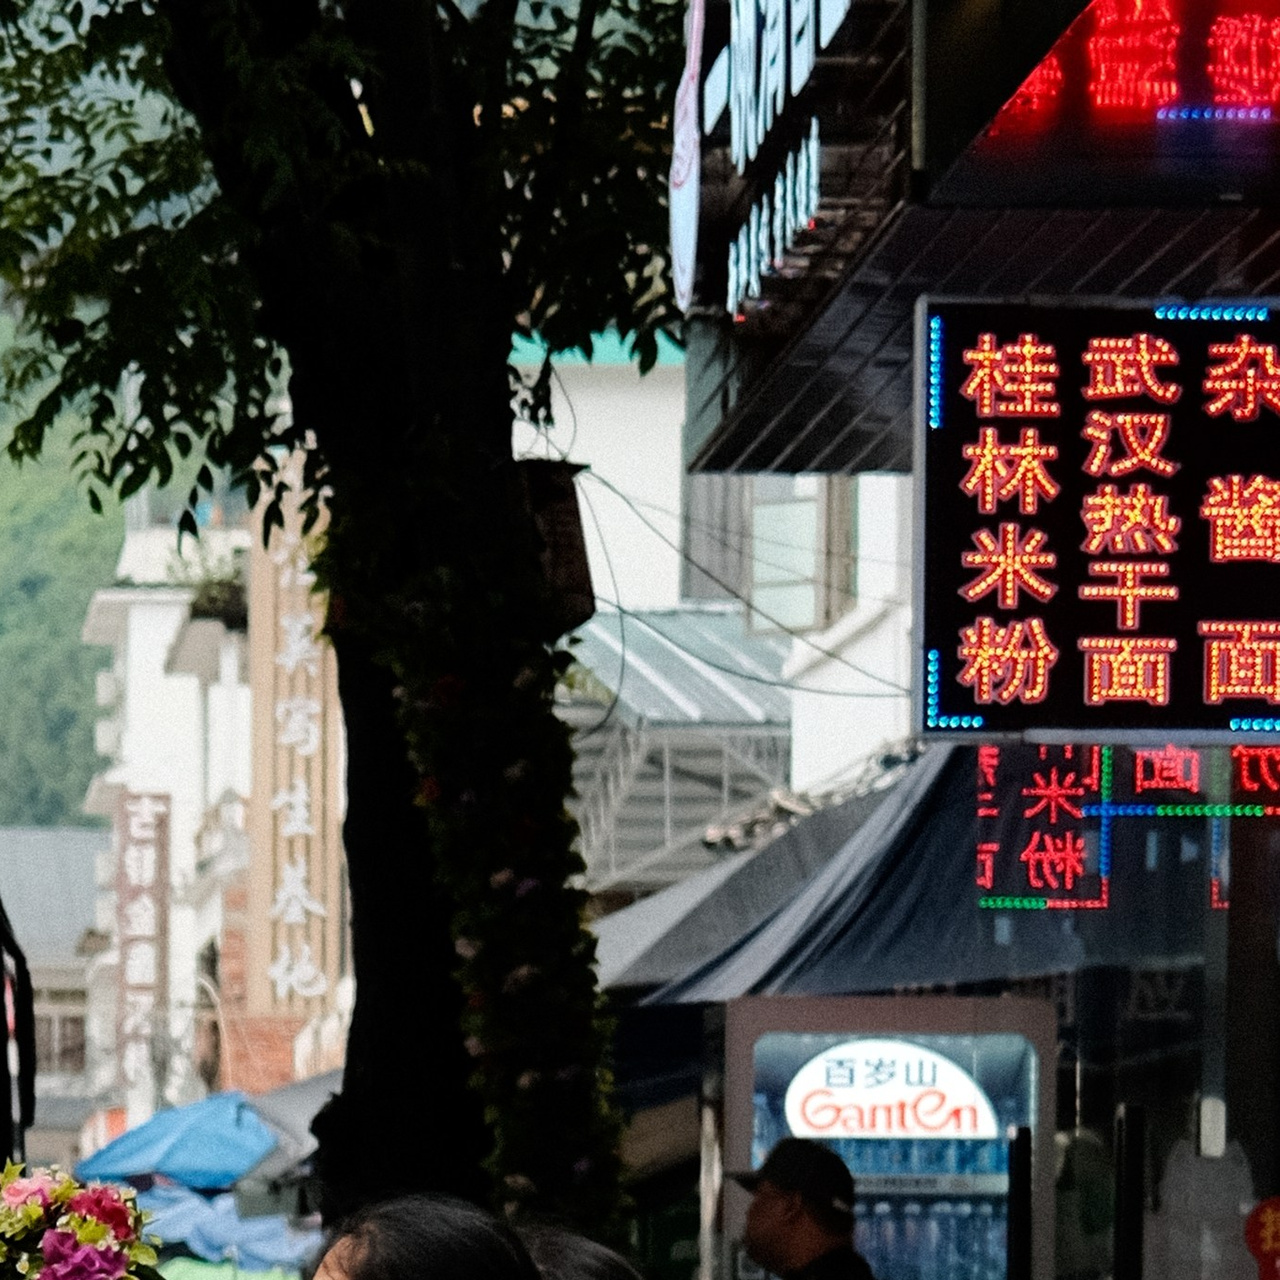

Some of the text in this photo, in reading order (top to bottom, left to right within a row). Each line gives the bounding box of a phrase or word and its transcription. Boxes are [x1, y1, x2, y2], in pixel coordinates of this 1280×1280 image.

[958, 333, 1060, 704] 桂林米粉
[1078, 332, 1182, 705] 武汉热干面
[1198, 333, 1280, 705] 杂酱面
[825, 1057, 937, 1088] 百岁山
